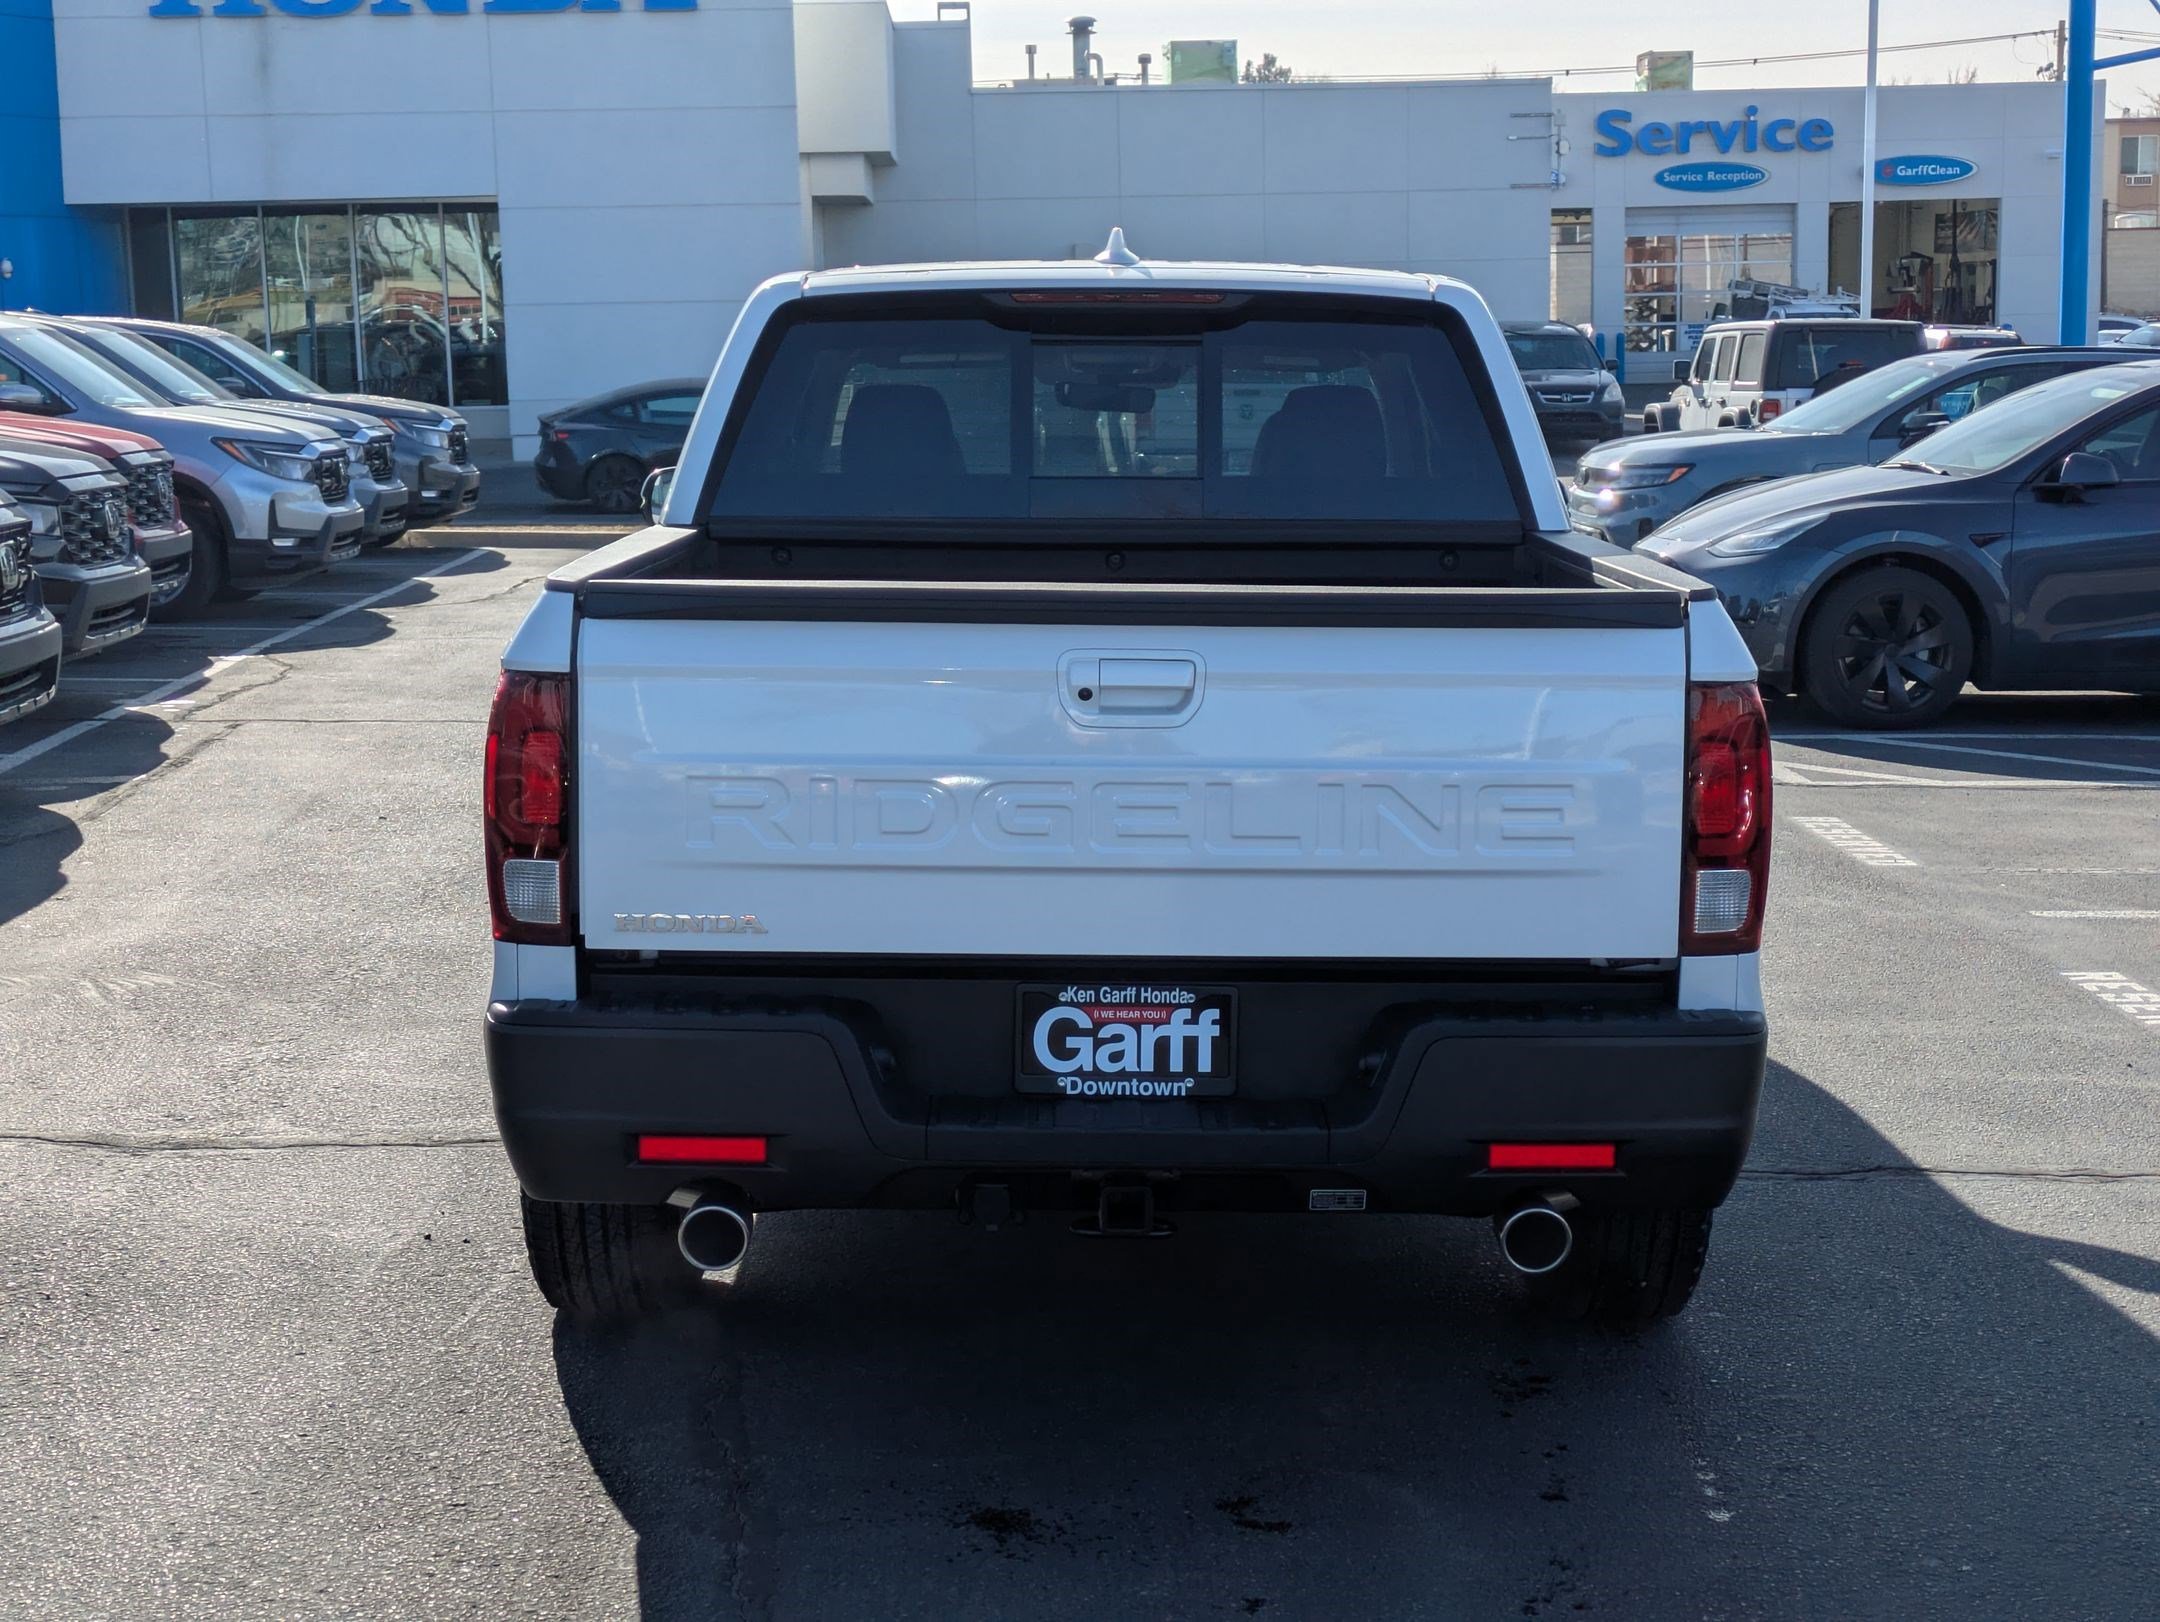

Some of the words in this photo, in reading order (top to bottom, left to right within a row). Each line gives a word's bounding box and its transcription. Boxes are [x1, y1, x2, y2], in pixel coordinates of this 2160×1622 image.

[1594, 105, 1834, 157] Service
[1663, 171, 1703, 183] Service
[1707, 170, 1762, 184] Reception
[1897, 165, 1961, 177] GarffClean
[685, 775, 1576, 858] RIDGELINE
[613, 912, 768, 935] HONDA
[1067, 986, 1095, 1003] Ken
[1100, 987, 1136, 1004] Garff
[1141, 988, 1187, 1005] Honda
[1100, 1010, 1115, 1019] WE
[1116, 1010, 1141, 1019] HEAR
[1142, 1010, 1160, 1019] YOU
[1033, 1006, 1220, 1073] Garff
[1066, 1077, 1187, 1096] Downtown
